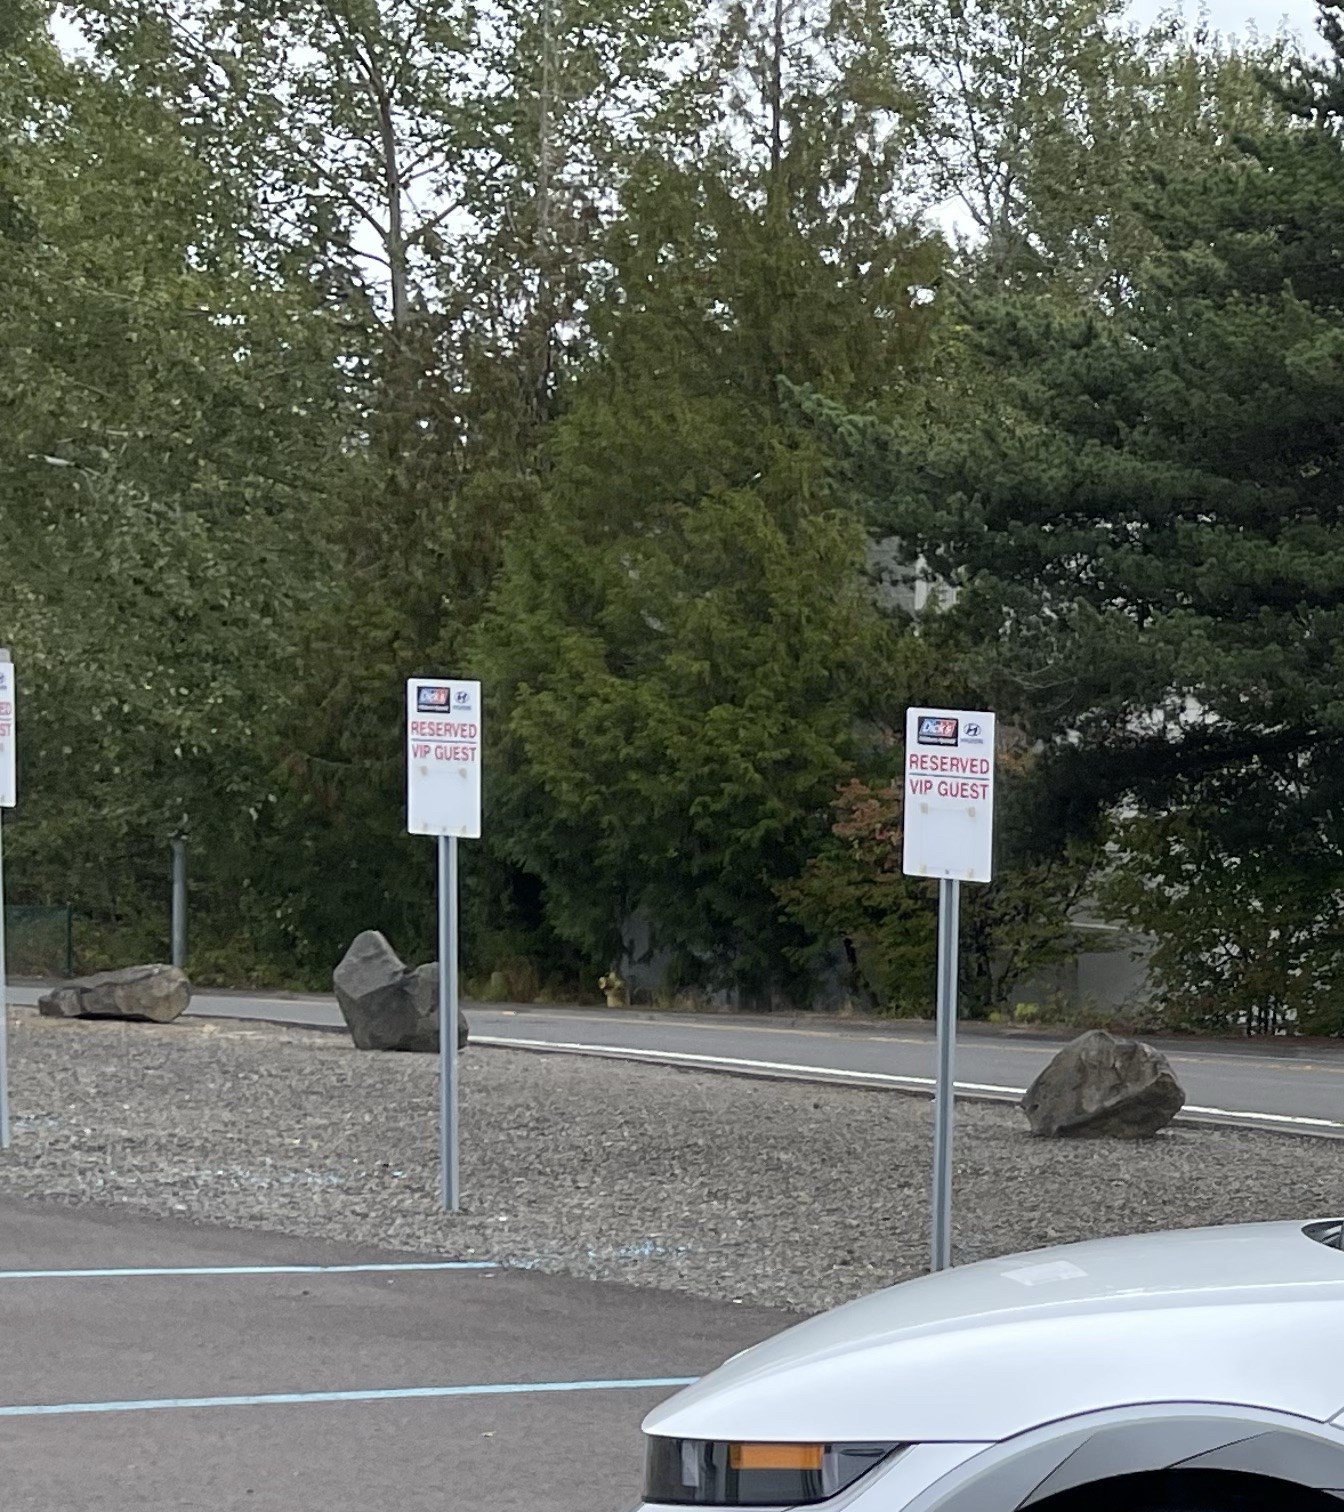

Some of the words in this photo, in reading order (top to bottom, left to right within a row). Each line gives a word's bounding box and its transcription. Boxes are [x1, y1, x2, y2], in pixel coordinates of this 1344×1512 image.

[411, 721, 477, 739] RESERVED
[412, 743, 431, 758] VIP
[435, 744, 477, 761] GUEST
[909, 754, 990, 774] RESERVED
[910, 779, 933, 794] VIP
[938, 781, 989, 800] GUEST
